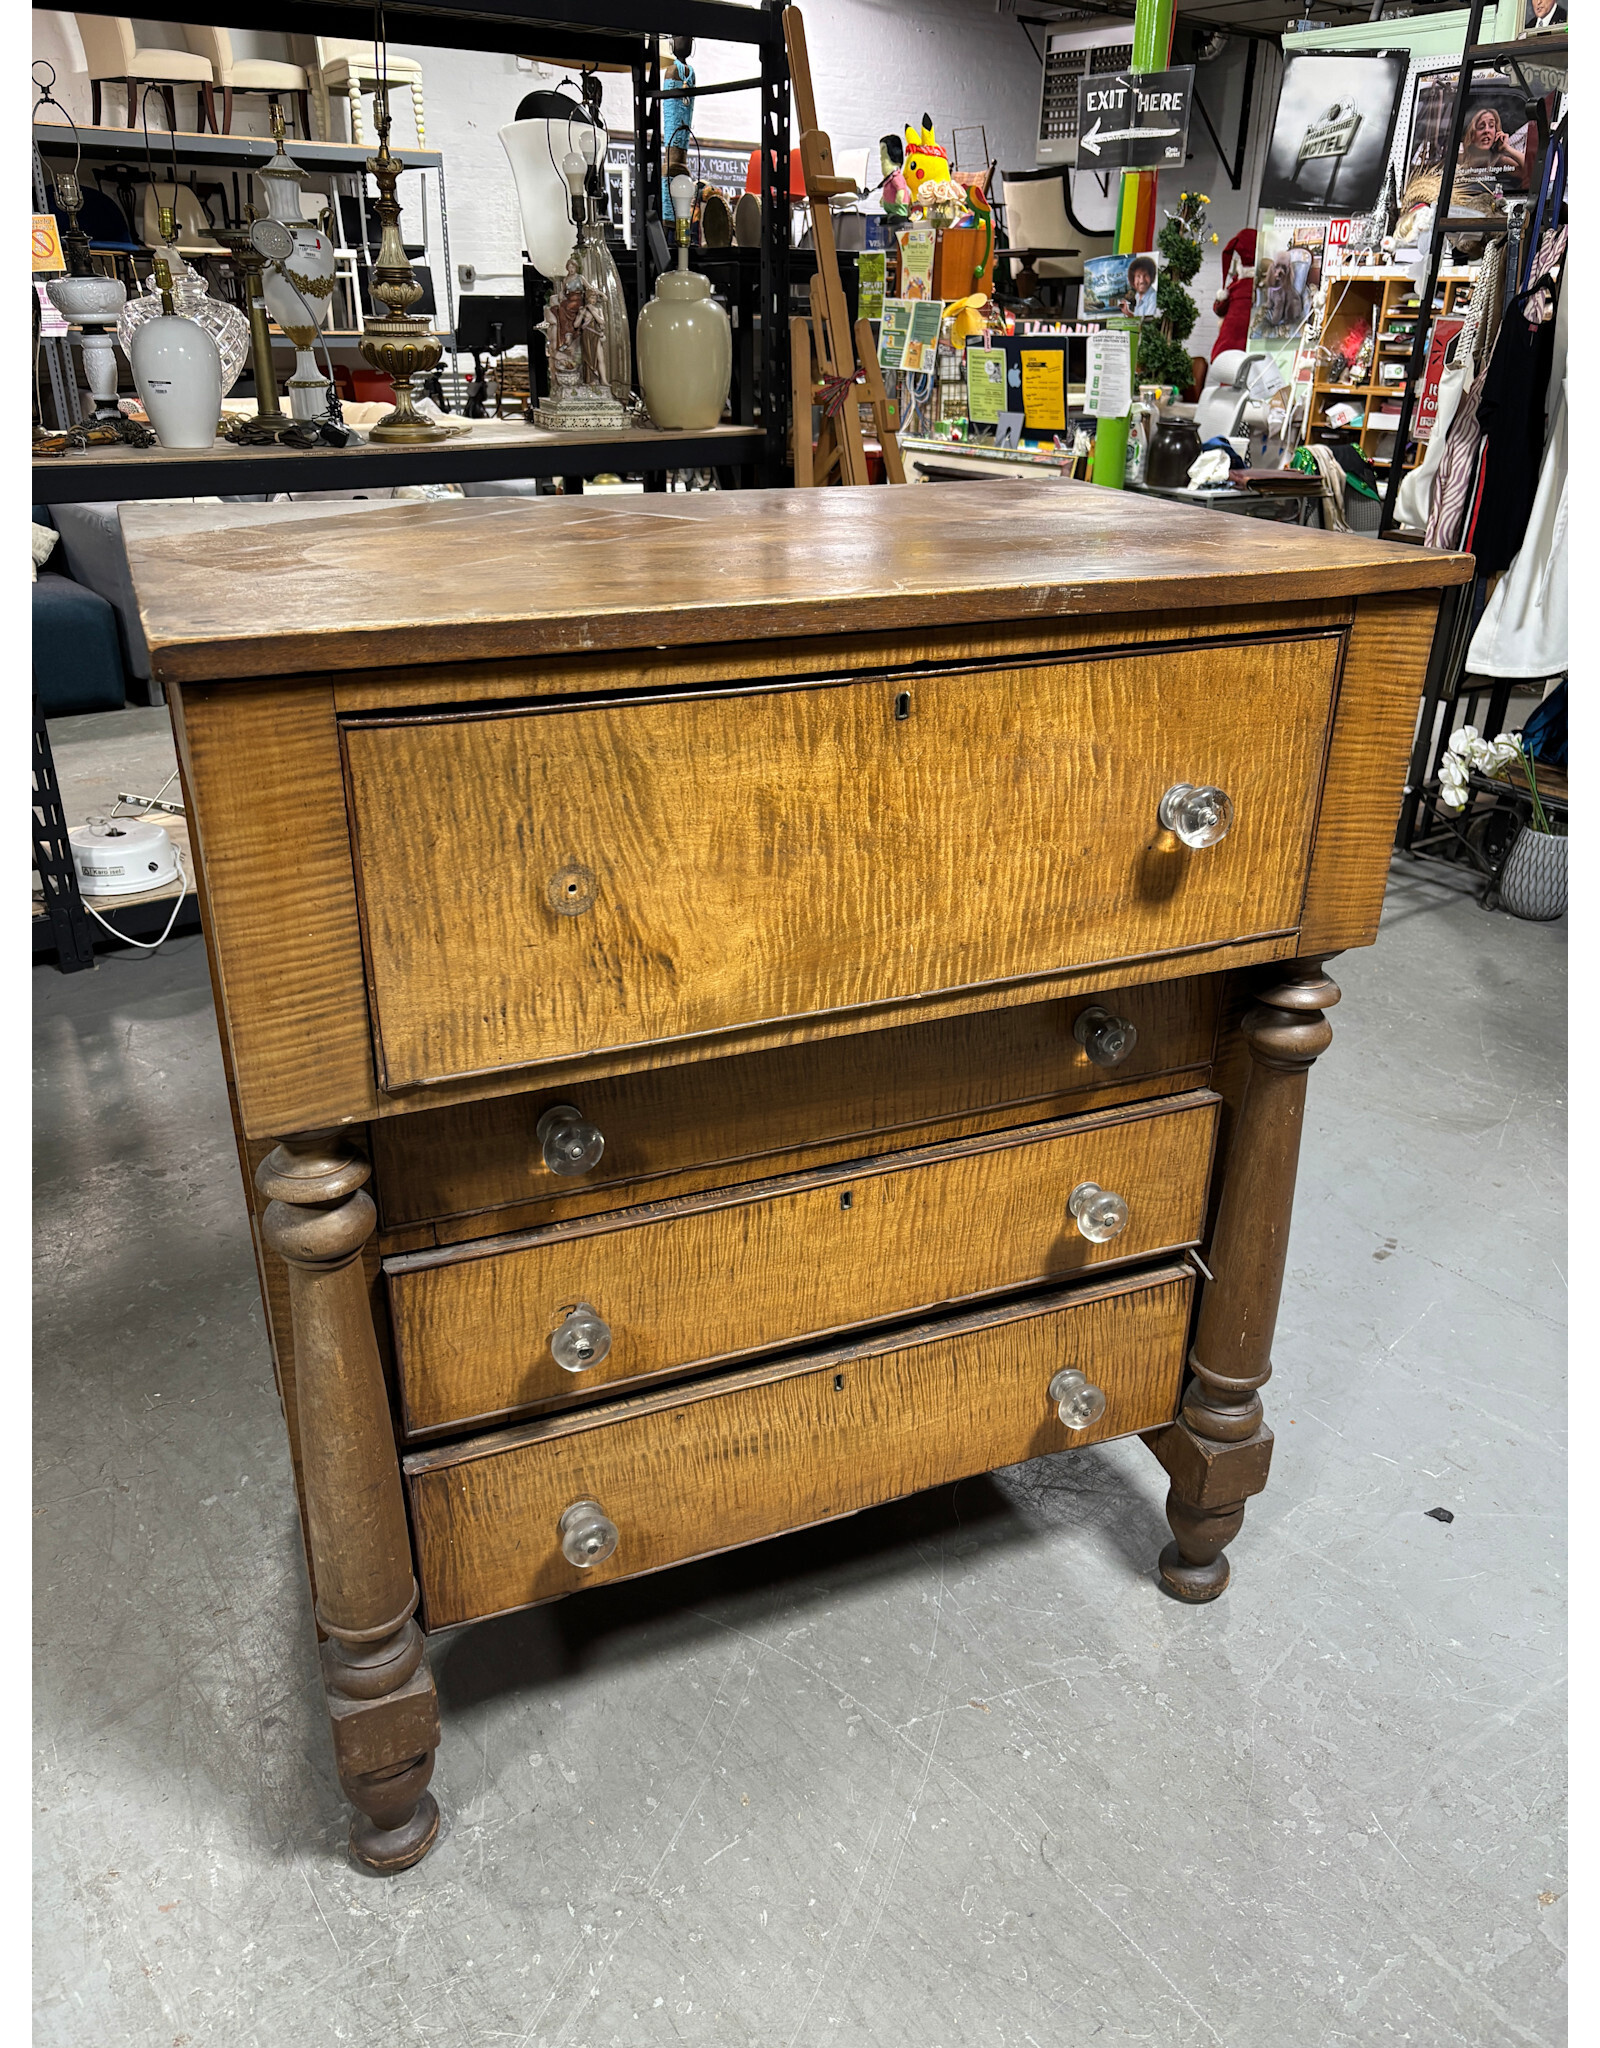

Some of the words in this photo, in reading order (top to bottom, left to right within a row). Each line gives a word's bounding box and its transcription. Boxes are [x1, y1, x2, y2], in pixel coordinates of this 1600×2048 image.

[1087, 89, 1127, 112] EXIT
[1137, 92, 1183, 112] HERE
[1301, 134, 1346, 157] MOTEL
[609, 149, 635, 166] Welc
[1331, 221, 1350, 242] NO
